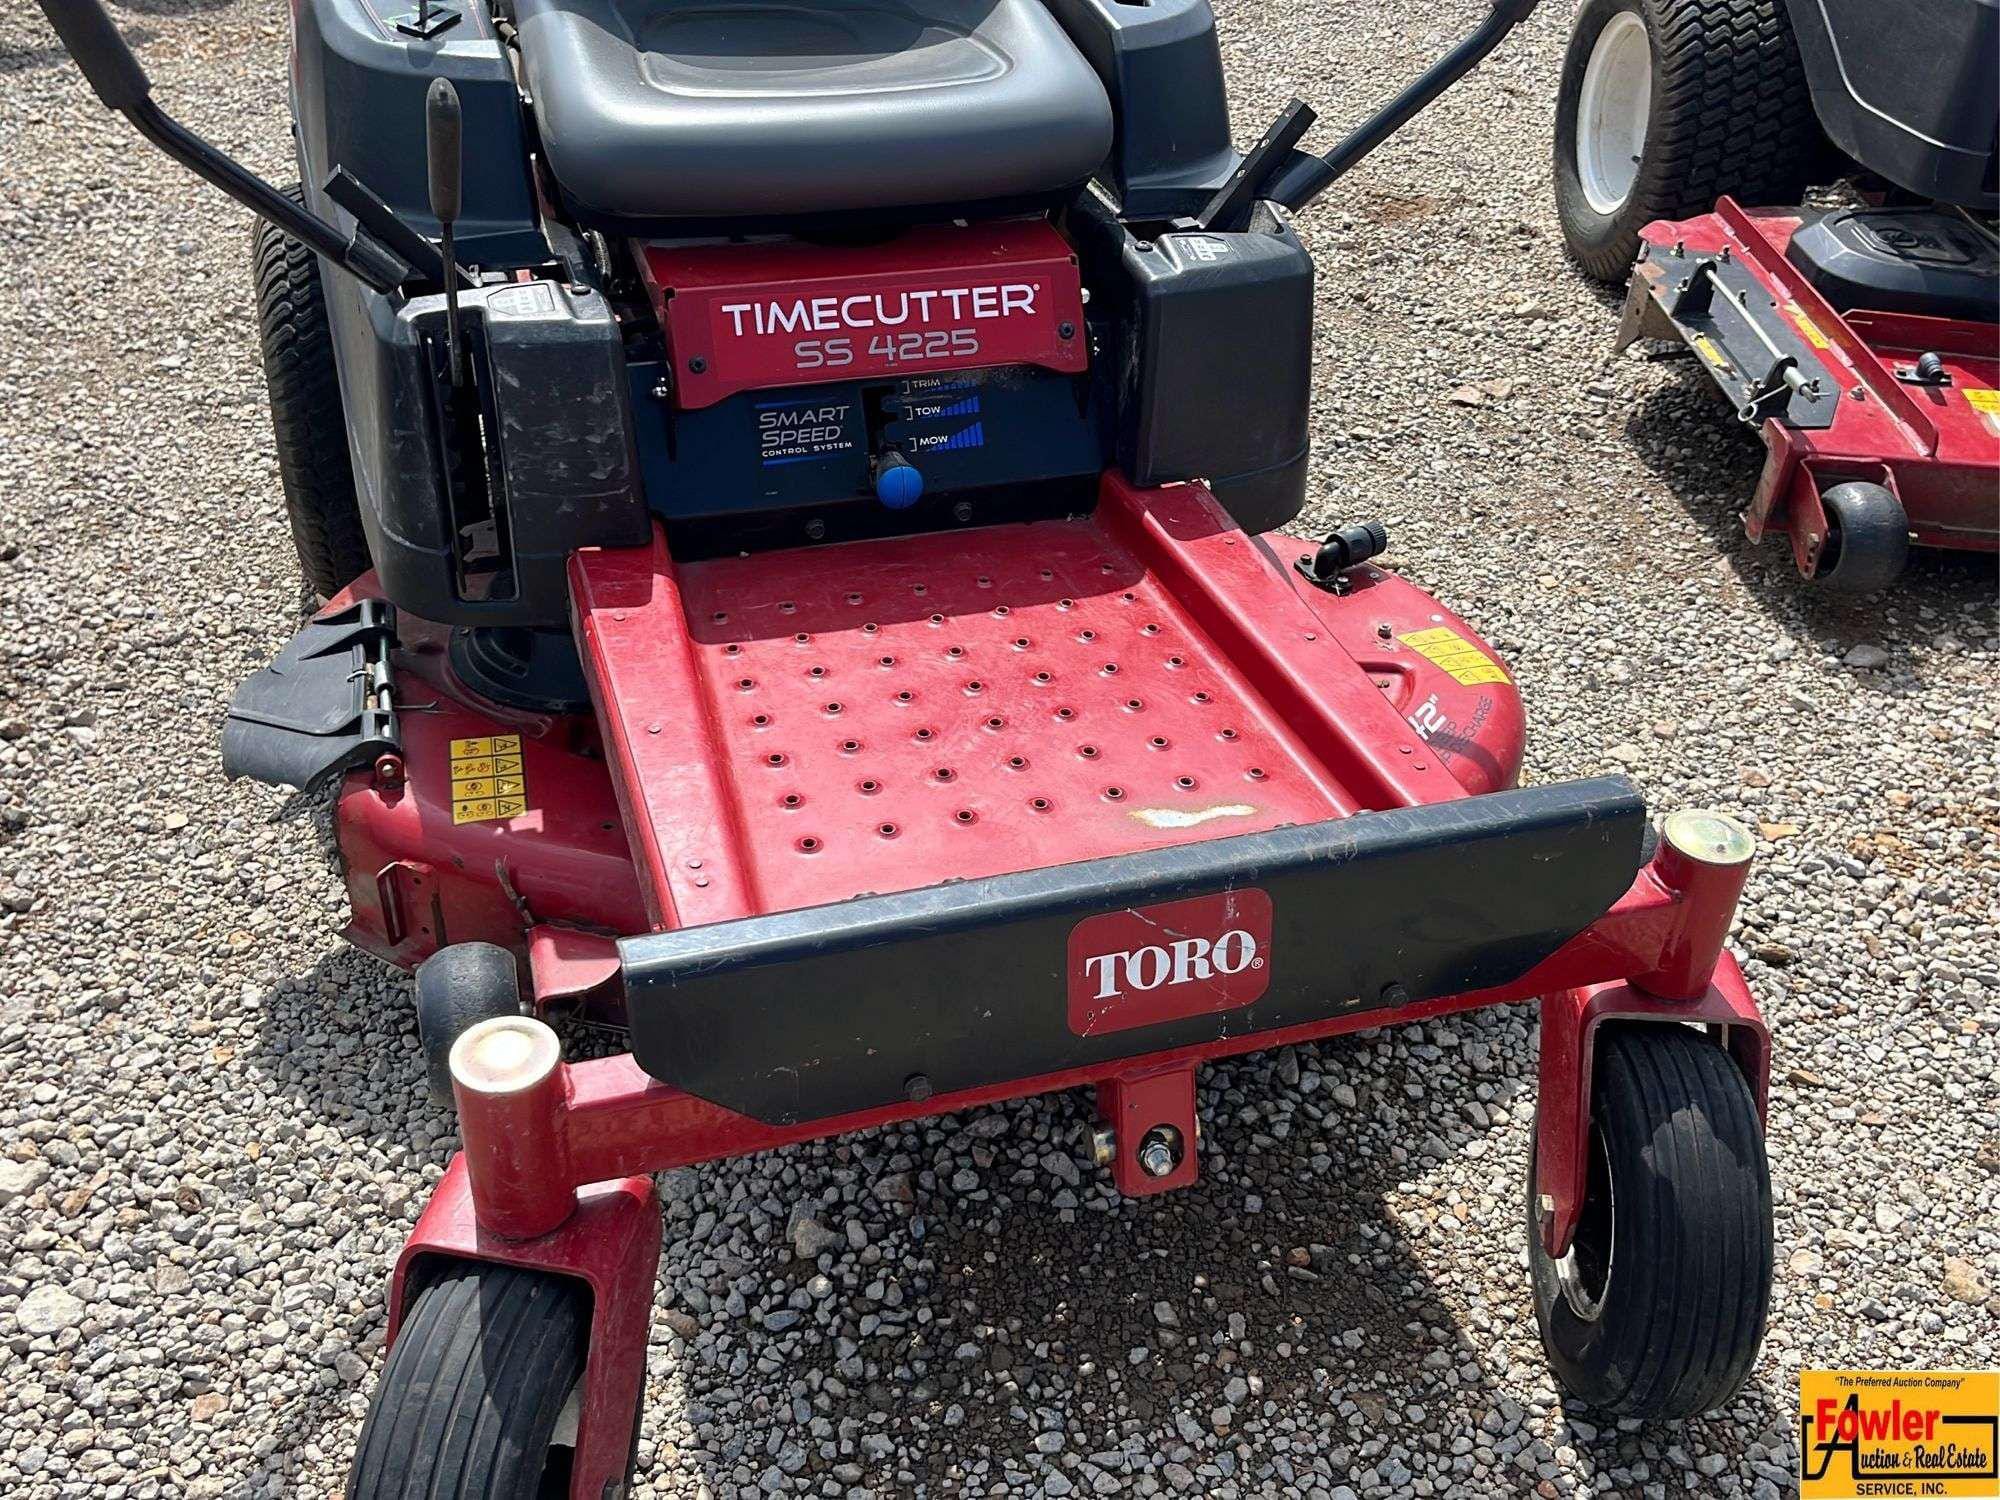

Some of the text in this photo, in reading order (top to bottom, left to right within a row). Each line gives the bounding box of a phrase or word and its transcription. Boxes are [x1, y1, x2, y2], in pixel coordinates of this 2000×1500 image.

[722, 284, 1037, 336] TIMECUTTER
[794, 329, 979, 368] SS 4225
[911, 378, 941, 390] TRIM
[759, 405, 850, 429] SMART
[915, 405, 941, 416] TOW
[761, 425, 842, 448] SPEED
[919, 435, 948, 446] MOW
[762, 441, 852, 458] CONTROL SYSTEM
